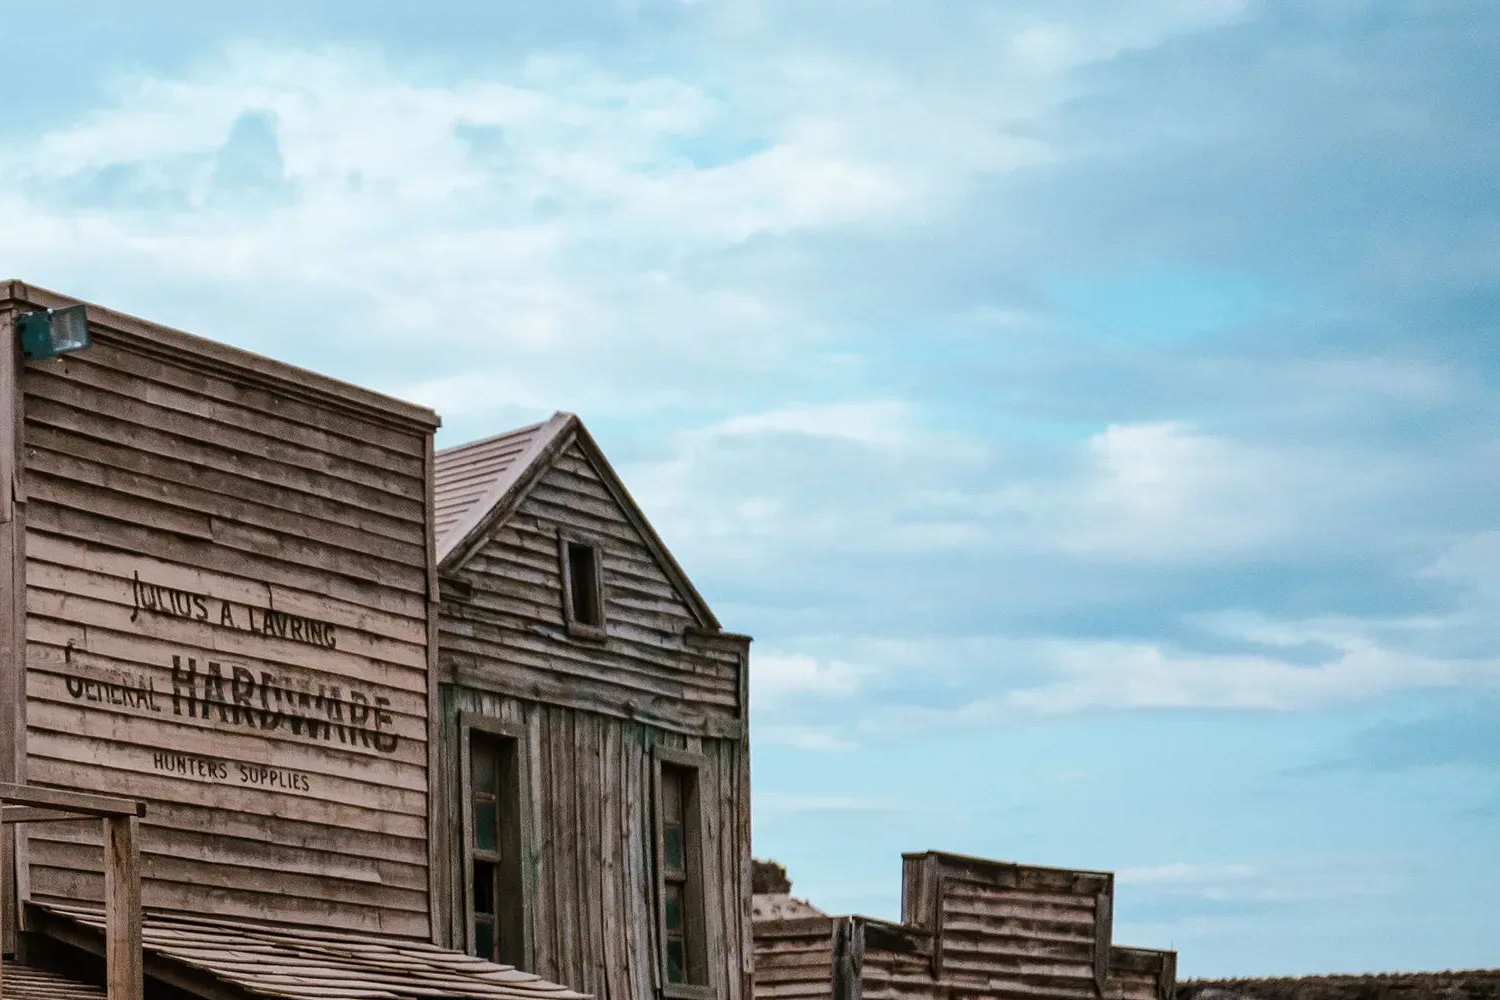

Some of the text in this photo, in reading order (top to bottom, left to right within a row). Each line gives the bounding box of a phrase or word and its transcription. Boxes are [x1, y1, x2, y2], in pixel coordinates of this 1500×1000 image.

[131, 570, 209, 623] JULIUS
[248, 607, 336, 650] LAVRING
[64, 638, 399, 754] GENERAL HARDWARE
[153, 753, 310, 792] HUNTERS SUPPLIES
